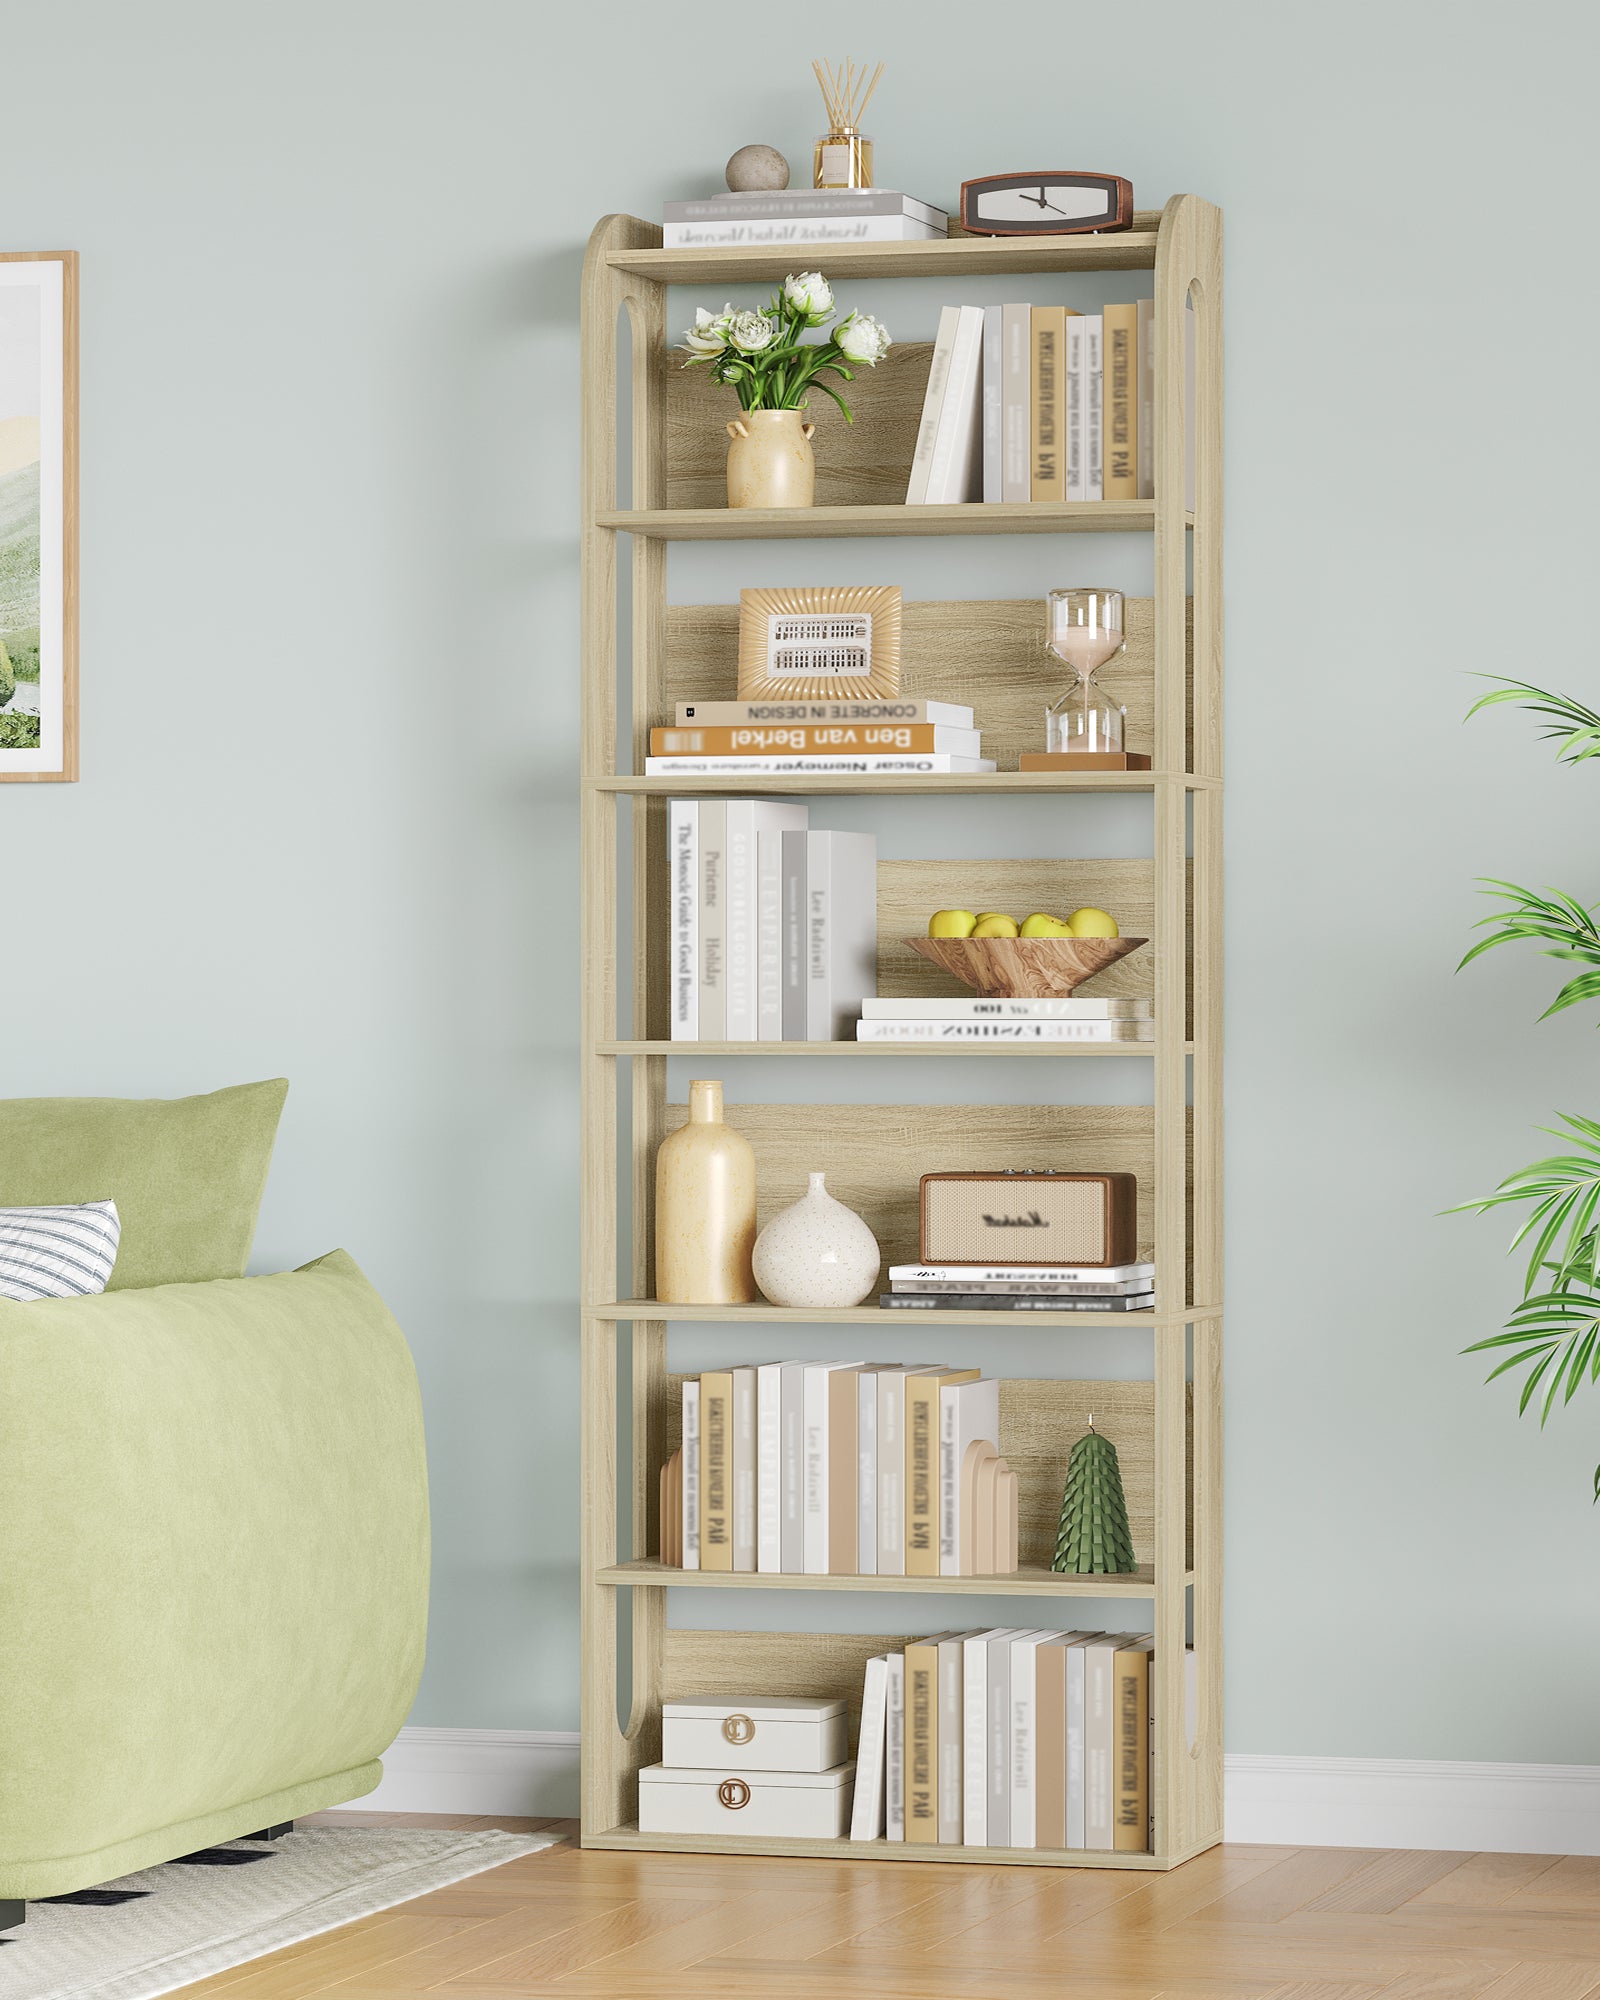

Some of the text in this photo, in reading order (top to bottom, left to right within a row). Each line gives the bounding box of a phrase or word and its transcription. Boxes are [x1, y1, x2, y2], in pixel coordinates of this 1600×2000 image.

[1111, 452, 1133, 478] РАЙ
[748, 704, 916, 720] CONCRETE IN DESIGN
[732, 728, 911, 749] Ben van Berkel
[774, 761, 867, 772] Niemeyer
[874, 762, 933, 772] Oscar
[811, 890, 825, 914] Lee
[678, 824, 692, 1022] The Monocle Guide to Good Business
[702, 937, 721, 988] Holiday
[708, 1517, 729, 1545] РАЙ
[913, 1792, 933, 1818] РАЙ
